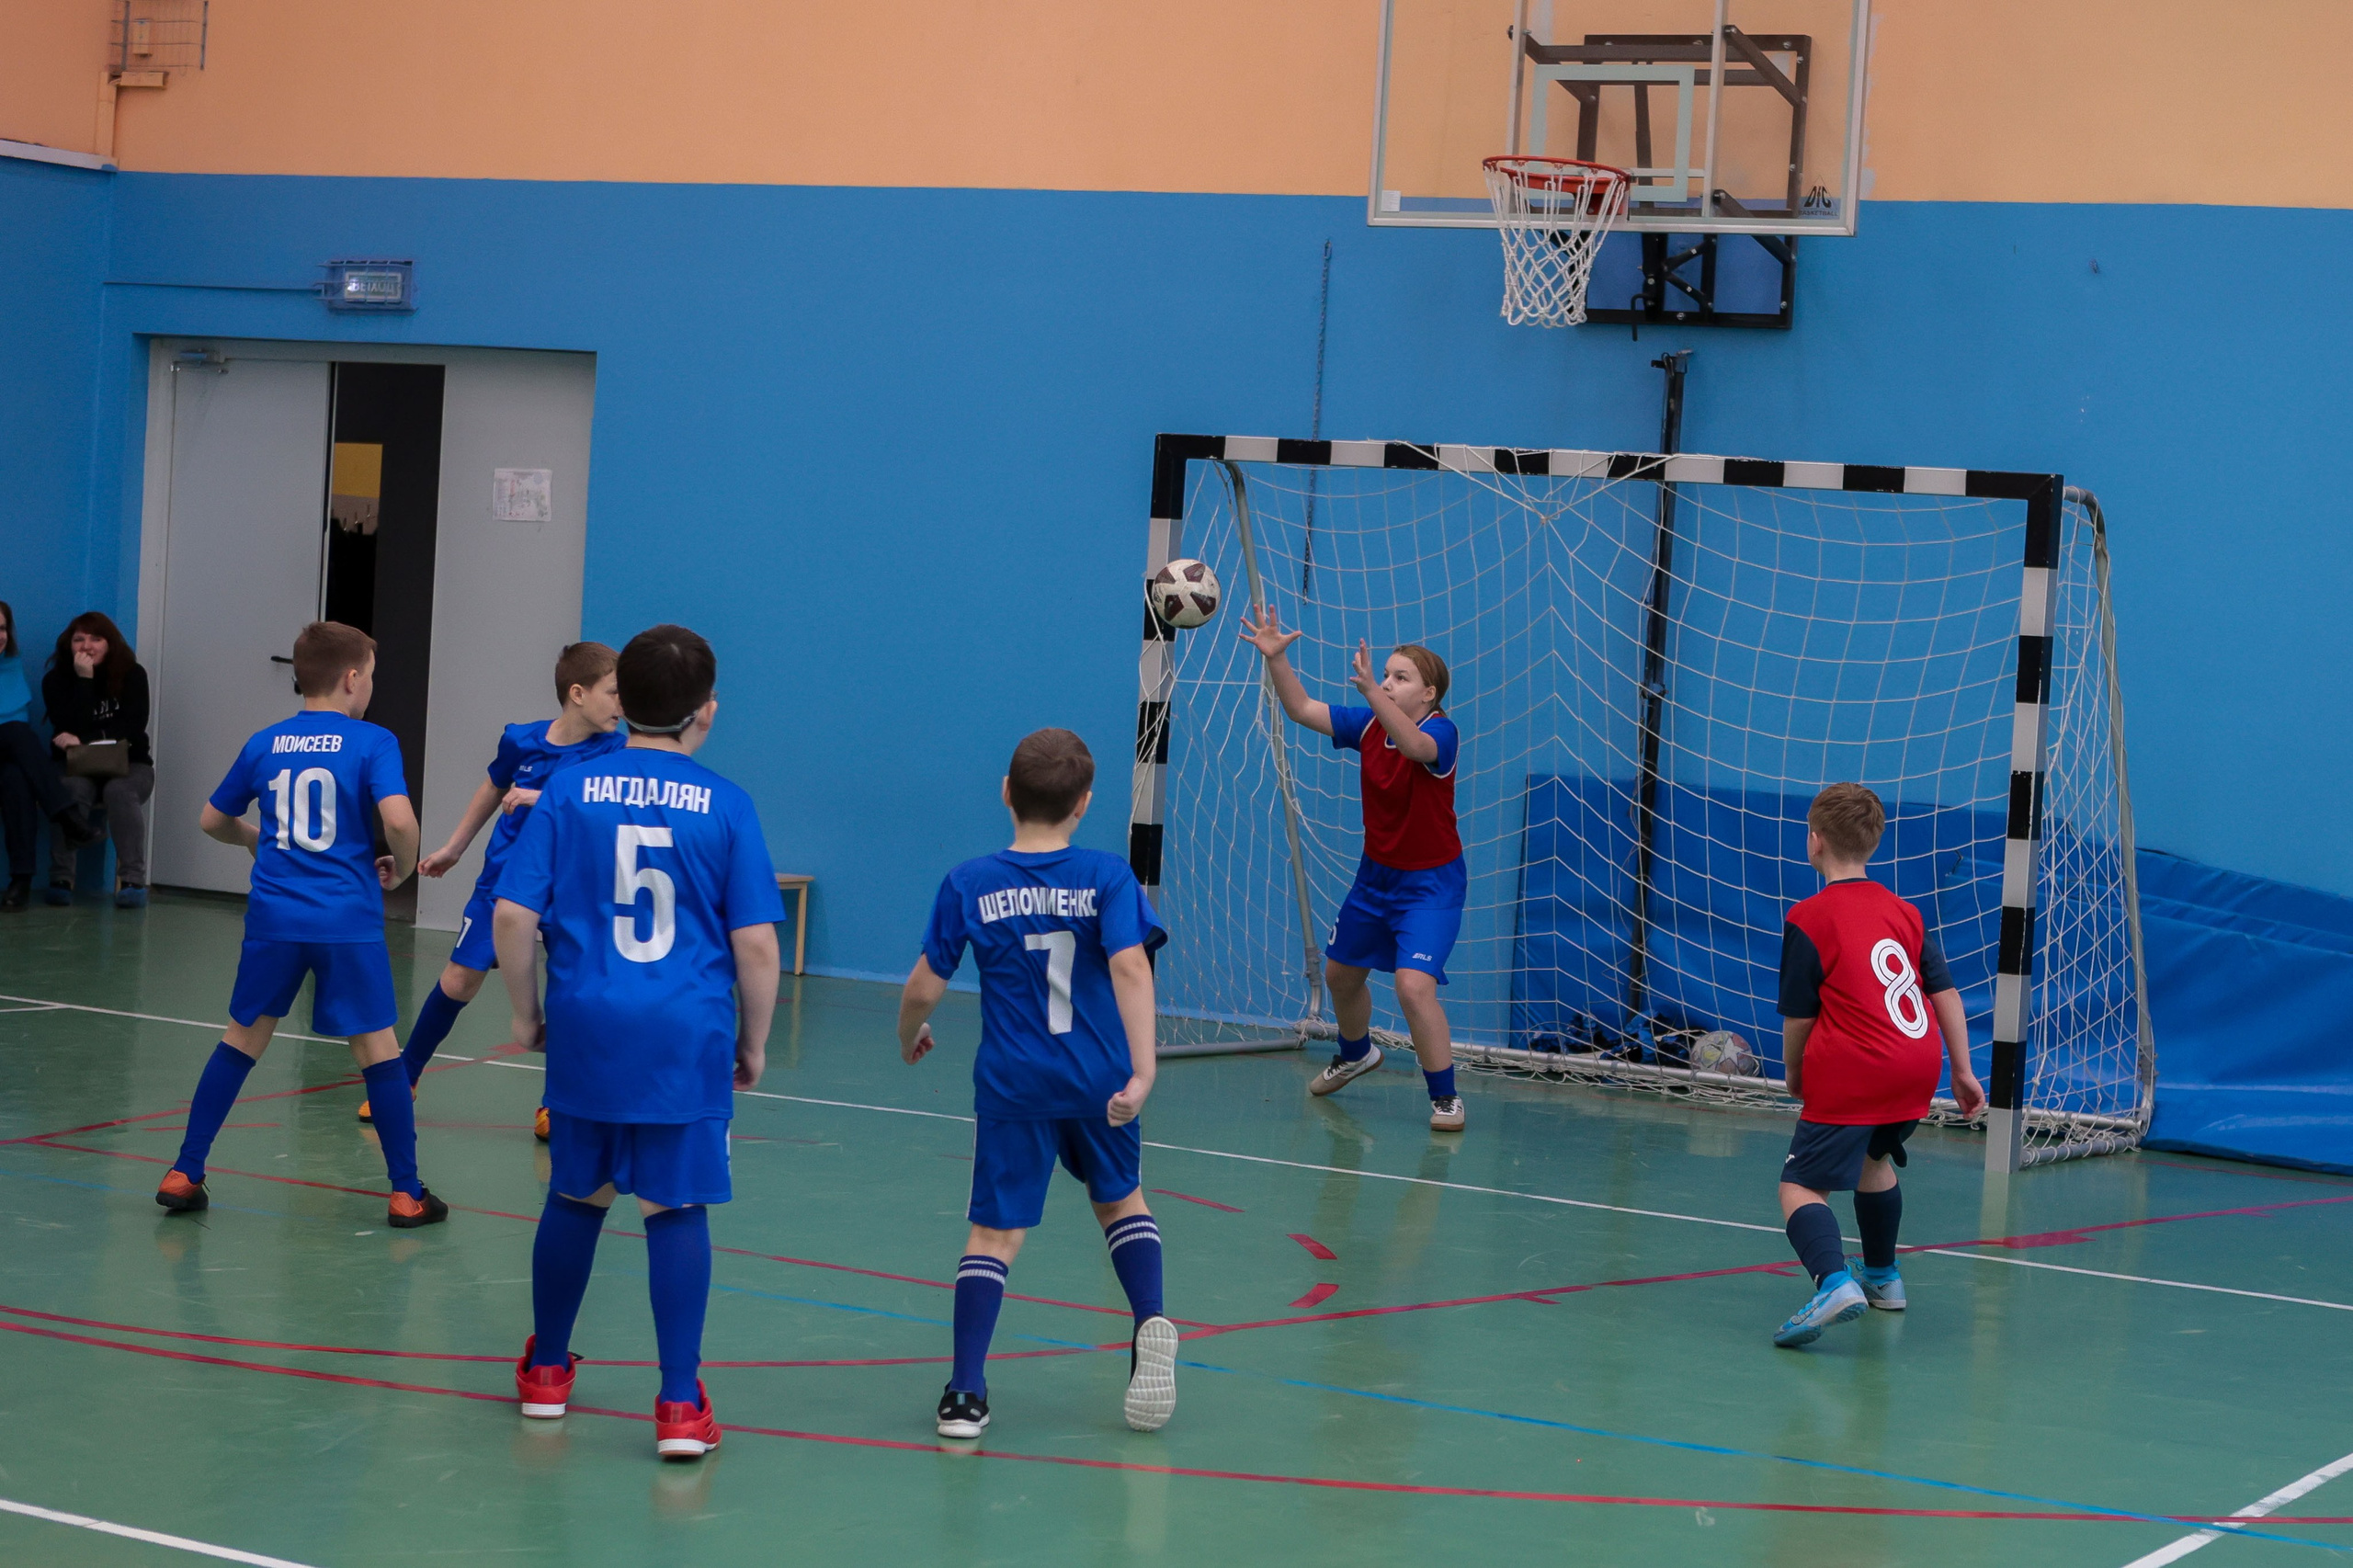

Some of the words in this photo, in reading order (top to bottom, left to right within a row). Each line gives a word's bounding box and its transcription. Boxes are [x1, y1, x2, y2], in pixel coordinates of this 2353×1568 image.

[272, 734, 343, 754] МОИСЕЕВ
[268, 767, 337, 853] 10
[583, 776, 711, 814] НАГДАЛЯН
[613, 824, 676, 963] 5
[1024, 930, 1076, 1036] 7
[1870, 937, 1929, 1040] 8
